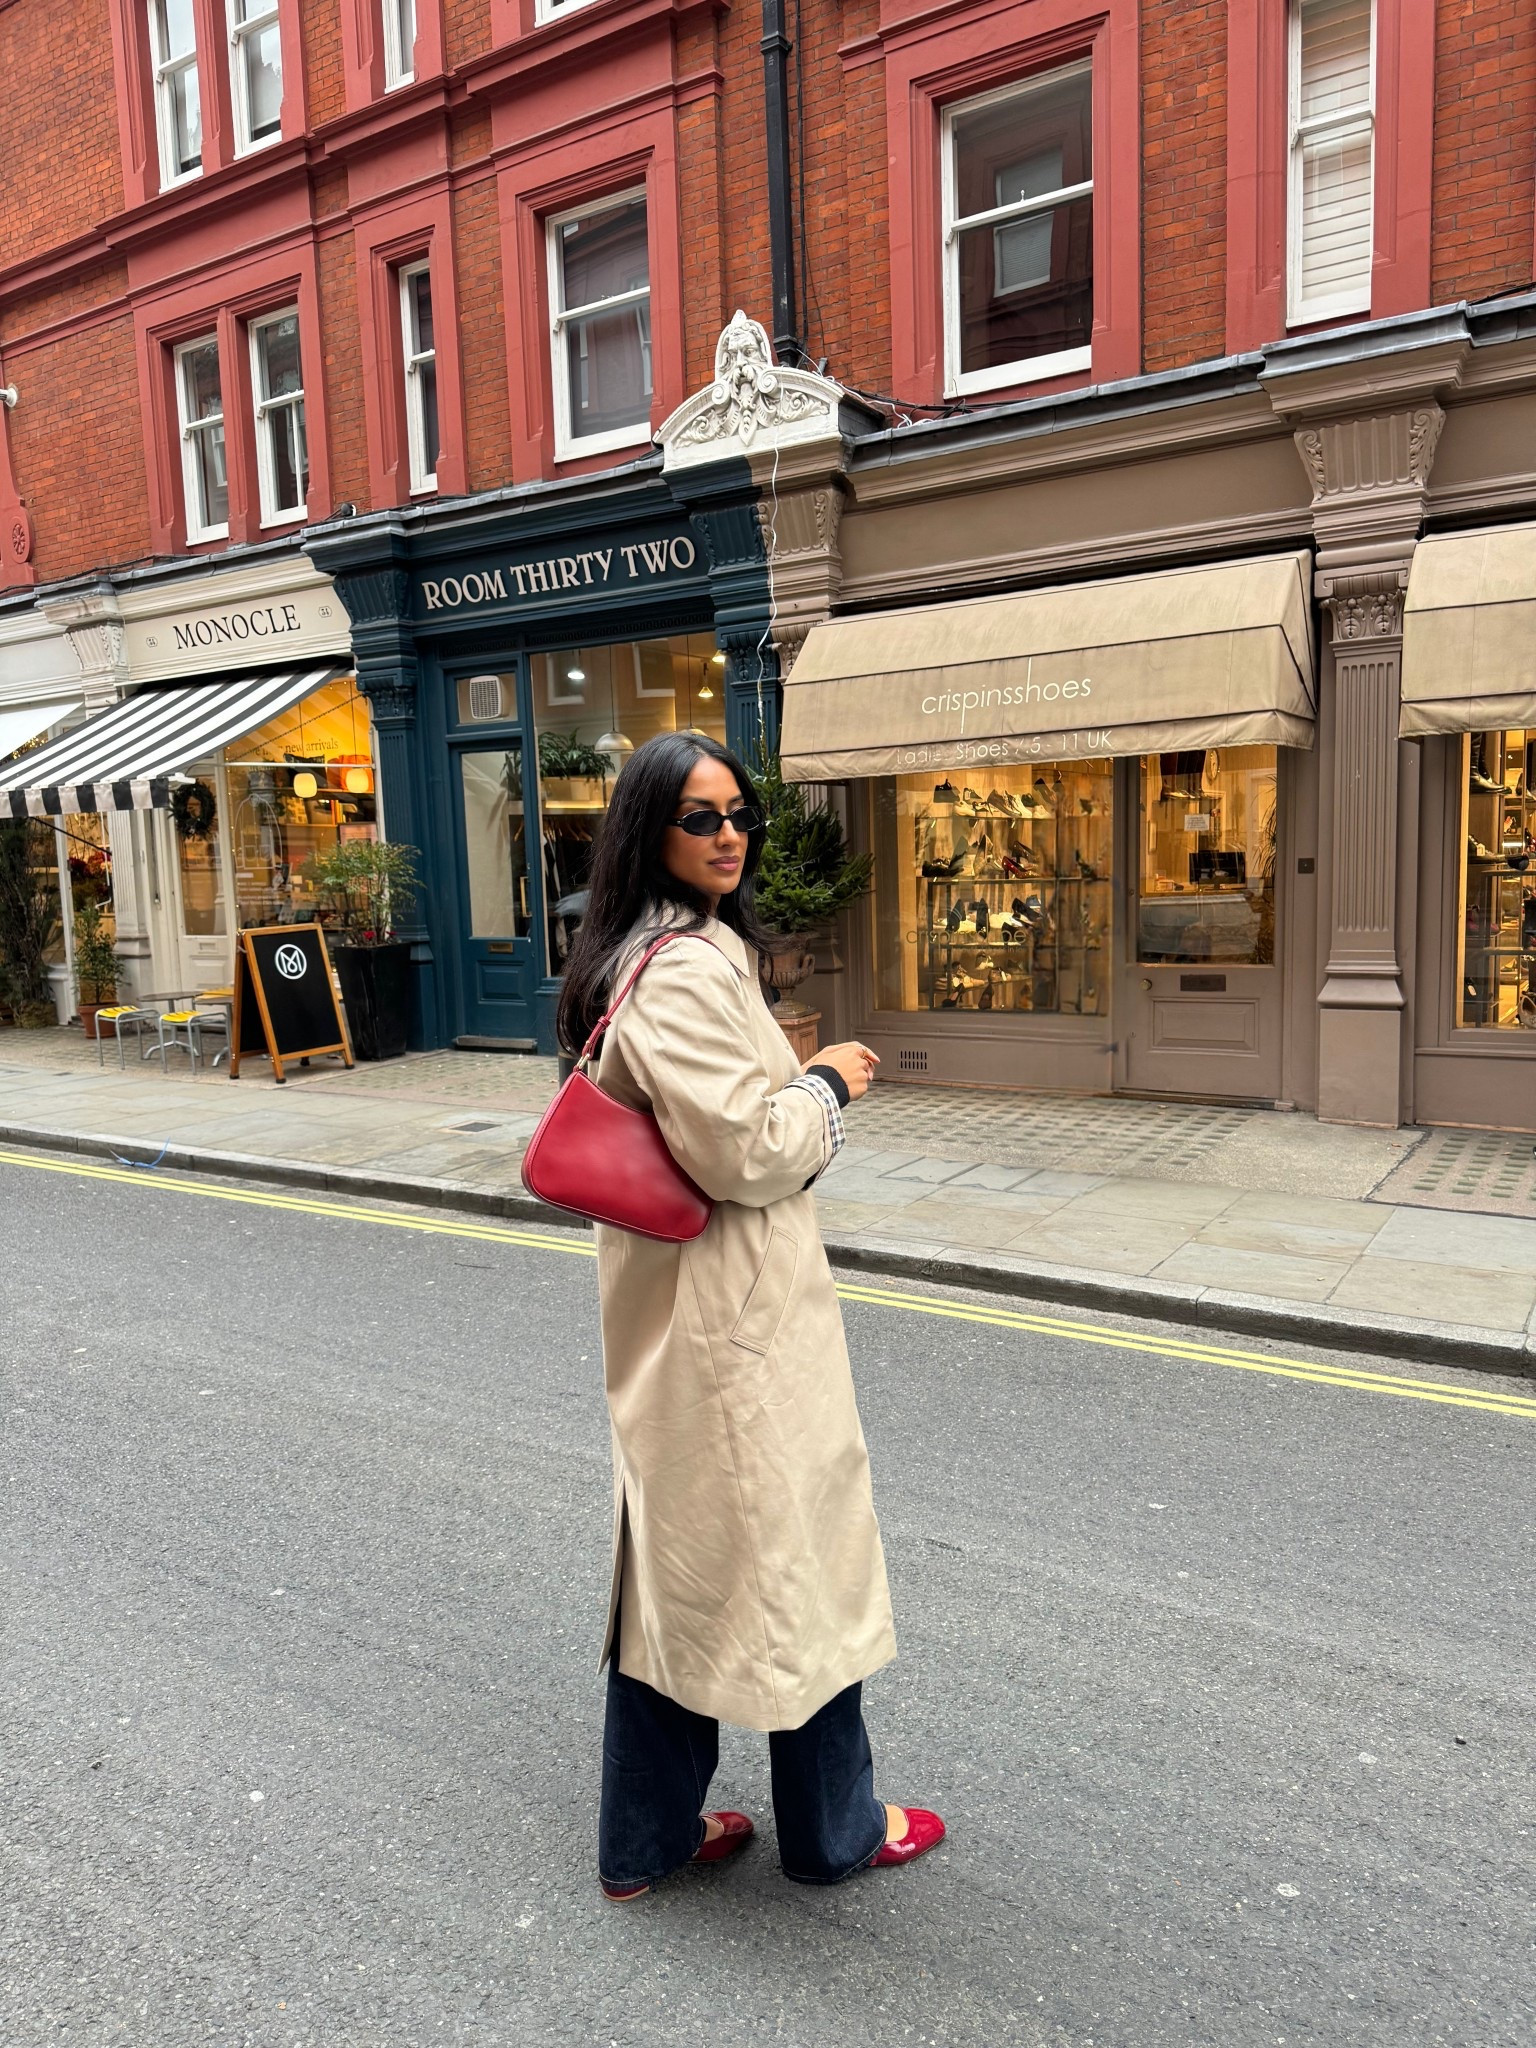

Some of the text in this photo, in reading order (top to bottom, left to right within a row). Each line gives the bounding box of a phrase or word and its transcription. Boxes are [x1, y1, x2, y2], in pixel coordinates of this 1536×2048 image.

[421, 536, 696, 610] ROOM THIRTY TWO
[172, 604, 301, 649] MONOCLE
[921, 657, 1092, 734] crispinsshoes
[306, 738, 339, 752] arrivals
[896, 746, 951, 765] Ladie
[956, 743, 1009, 760] Shoes
[1088, 730, 1113, 749] UK
